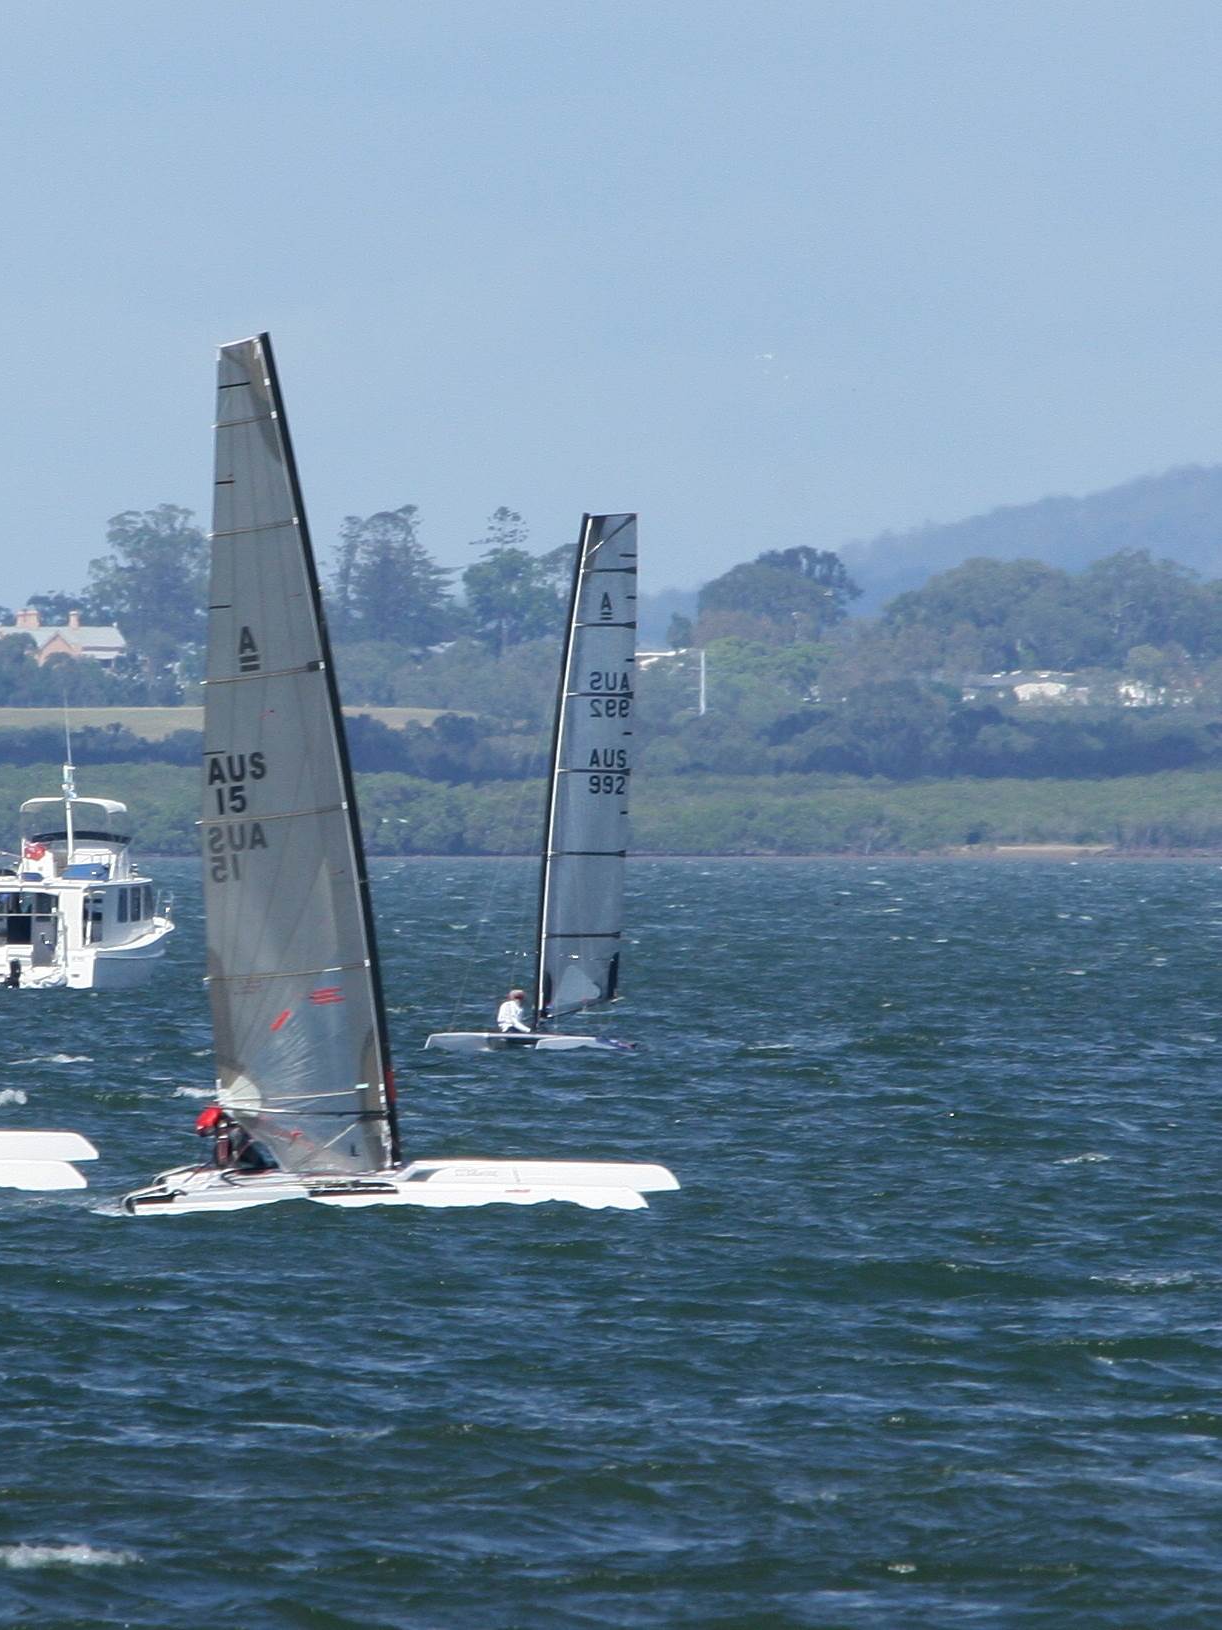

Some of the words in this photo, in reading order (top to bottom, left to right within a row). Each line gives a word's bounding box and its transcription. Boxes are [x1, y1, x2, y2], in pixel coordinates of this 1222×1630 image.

[600, 591, 613, 611] A
[238, 626, 257, 654] A
[207, 752, 267, 785] AUS
[589, 749, 627, 768] AUS
[588, 775, 626, 794] 992
[215, 785, 247, 815] 15
